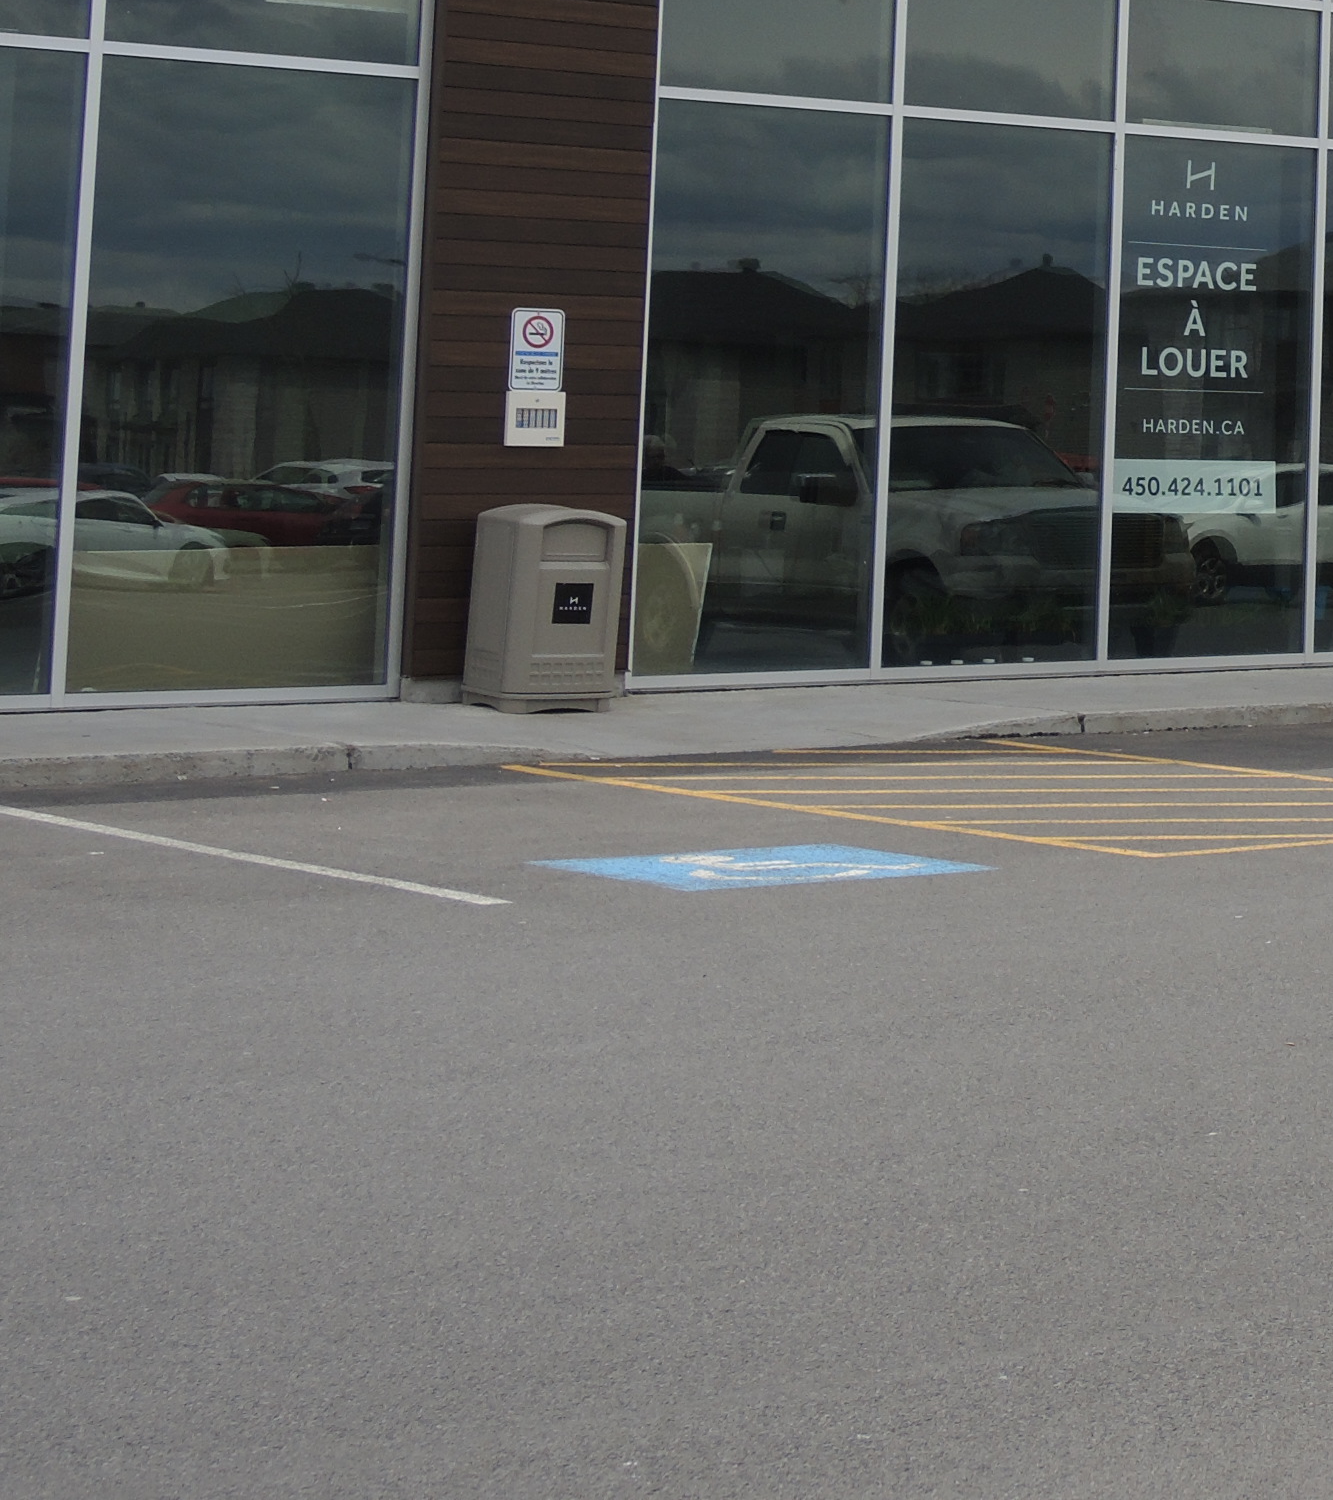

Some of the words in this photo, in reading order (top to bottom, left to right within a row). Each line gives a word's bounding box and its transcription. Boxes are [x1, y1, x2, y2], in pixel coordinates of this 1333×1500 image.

[1151, 200, 1248, 221] HARDEN
[1137, 257, 1257, 291] ESPACE
[1183, 300, 1206, 337] À
[1141, 346, 1248, 378] LOUER
[1143, 418, 1245, 435] HARDEN.CA
[1122, 476, 1263, 497] 450.424.1101
